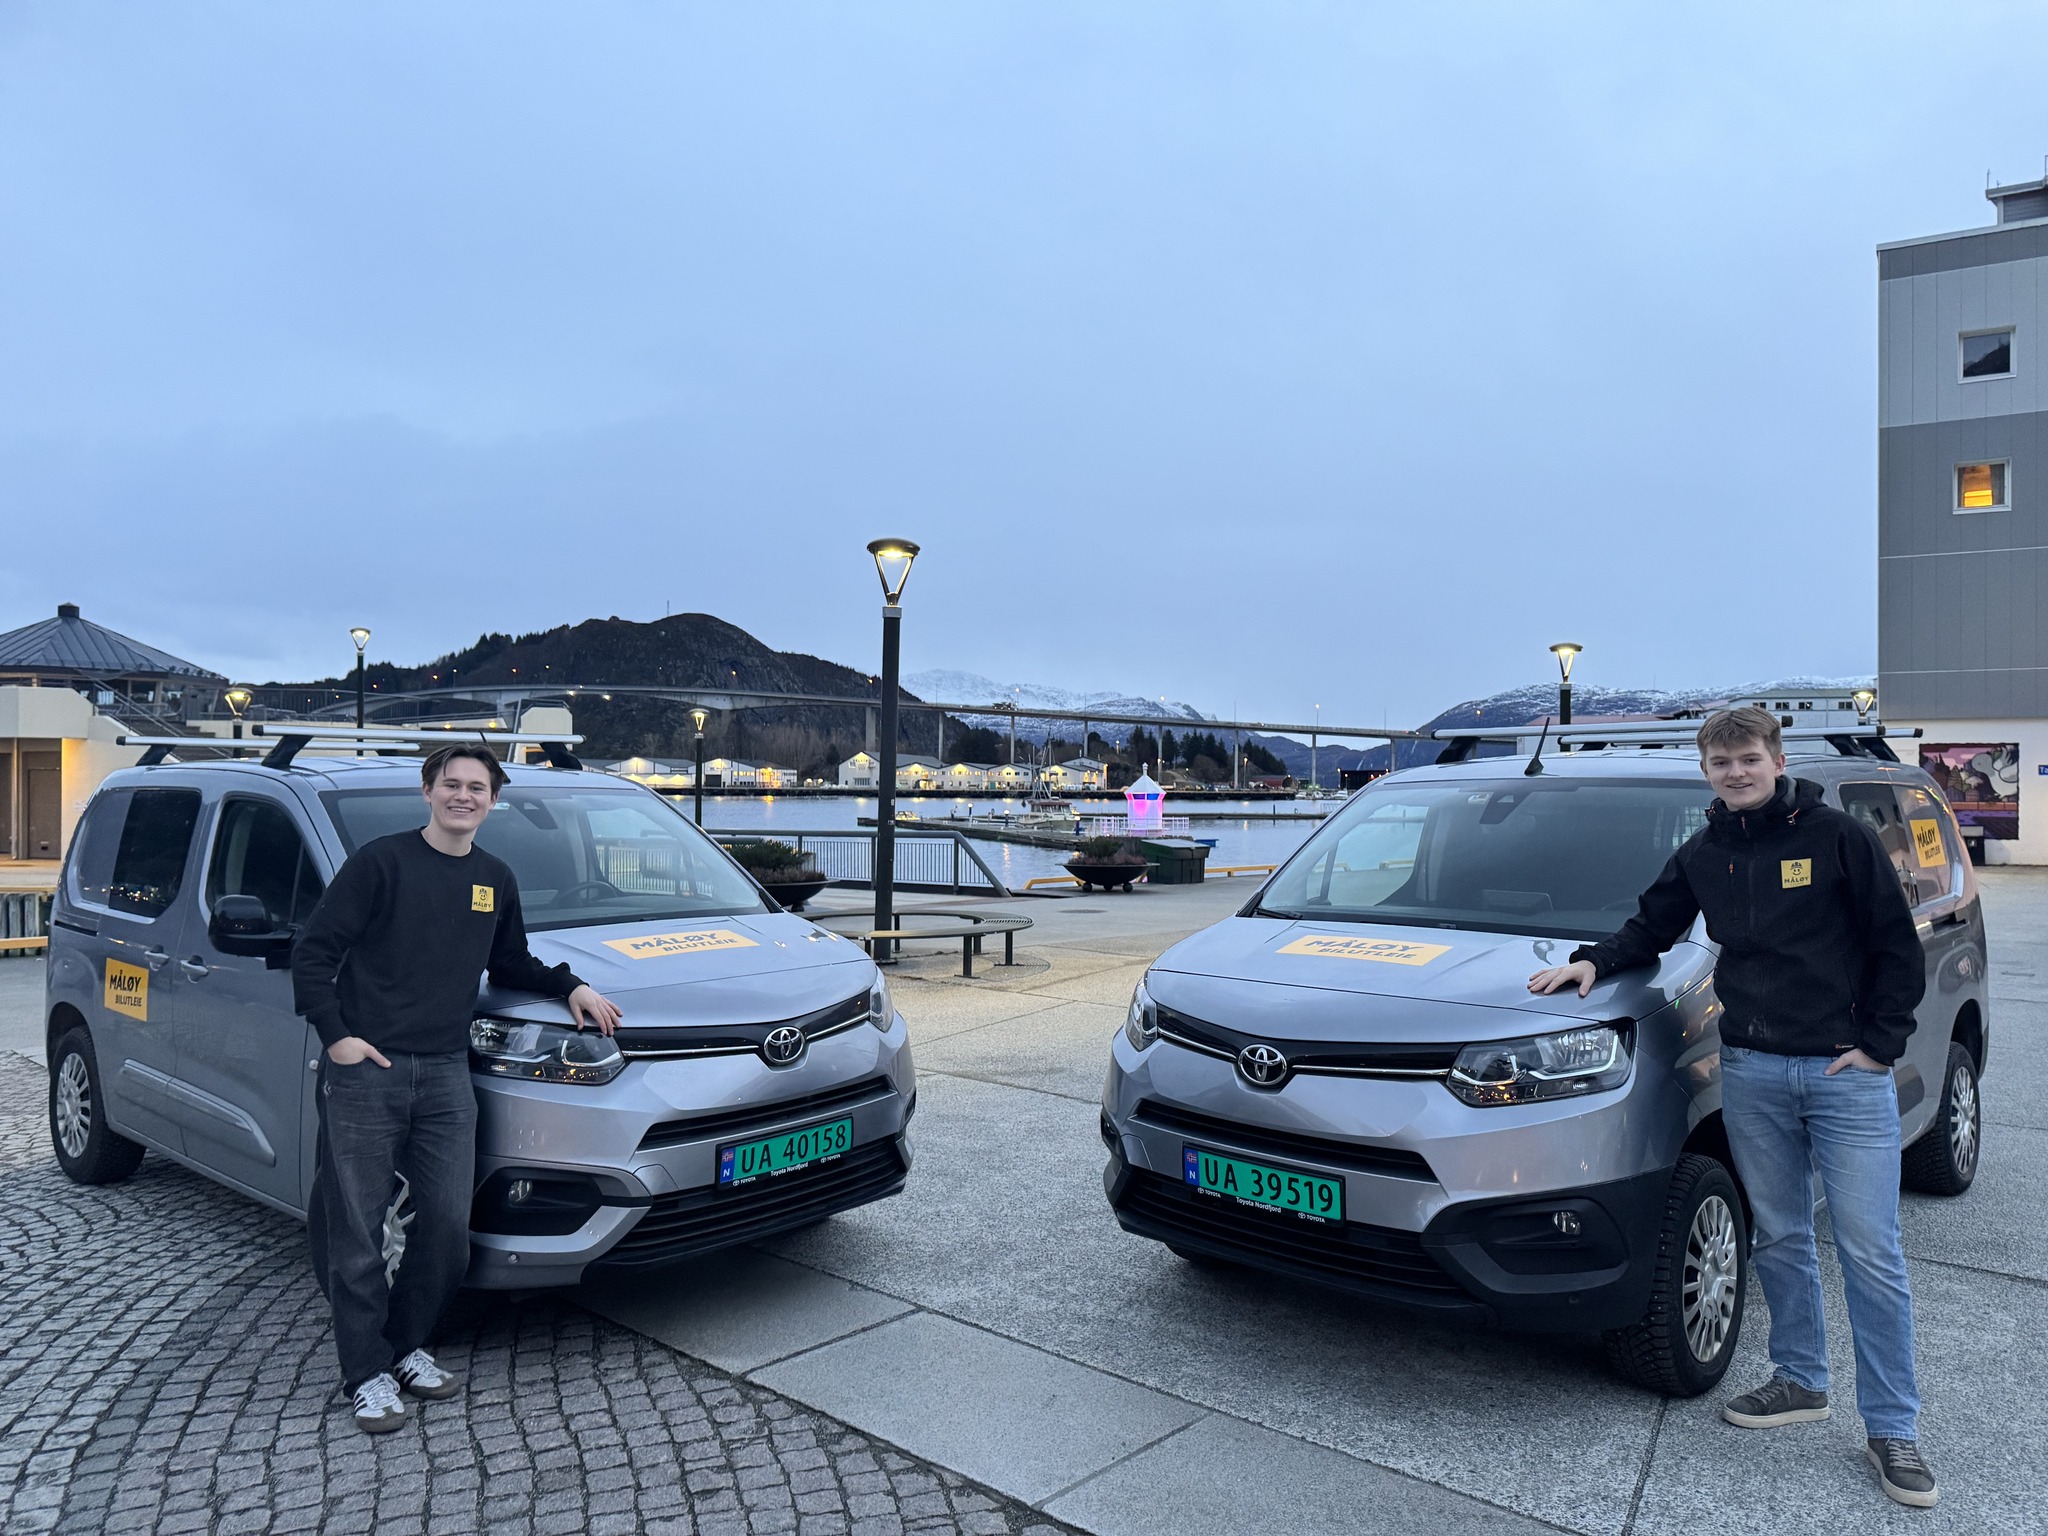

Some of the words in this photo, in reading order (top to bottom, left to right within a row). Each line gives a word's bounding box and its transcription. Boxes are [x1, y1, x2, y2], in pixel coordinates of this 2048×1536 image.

[1917, 826, 1936, 849] MÅLØY
[630, 933, 717, 950] MÅLØY
[663, 938, 738, 952] BILUTLEIE
[1304, 939, 1424, 952] MÅLØY
[1317, 947, 1416, 959] BILUTLEIE
[109, 969, 141, 992] MÅLØY
[115, 994, 142, 1007] BILUTLEIE
[741, 1143, 772, 1174] UA
[783, 1123, 846, 1163] 40158
[826, 1153, 841, 1162] TOYOTA
[723, 1168, 730, 1177] N
[770, 1166, 786, 1177] Toyota
[786, 1161, 809, 1173] Nordfjord
[1189, 1170, 1196, 1180] N
[740, 1176, 756, 1184] TOYOTA
[1204, 1157, 1239, 1192] UA
[1250, 1169, 1333, 1213] 39519
[1205, 1189, 1221, 1198] TOYOTA
[1236, 1196, 1254, 1208] Toyota
[1255, 1199, 1281, 1213] Nordfjord
[1306, 1214, 1325, 1223] TOYOTA
